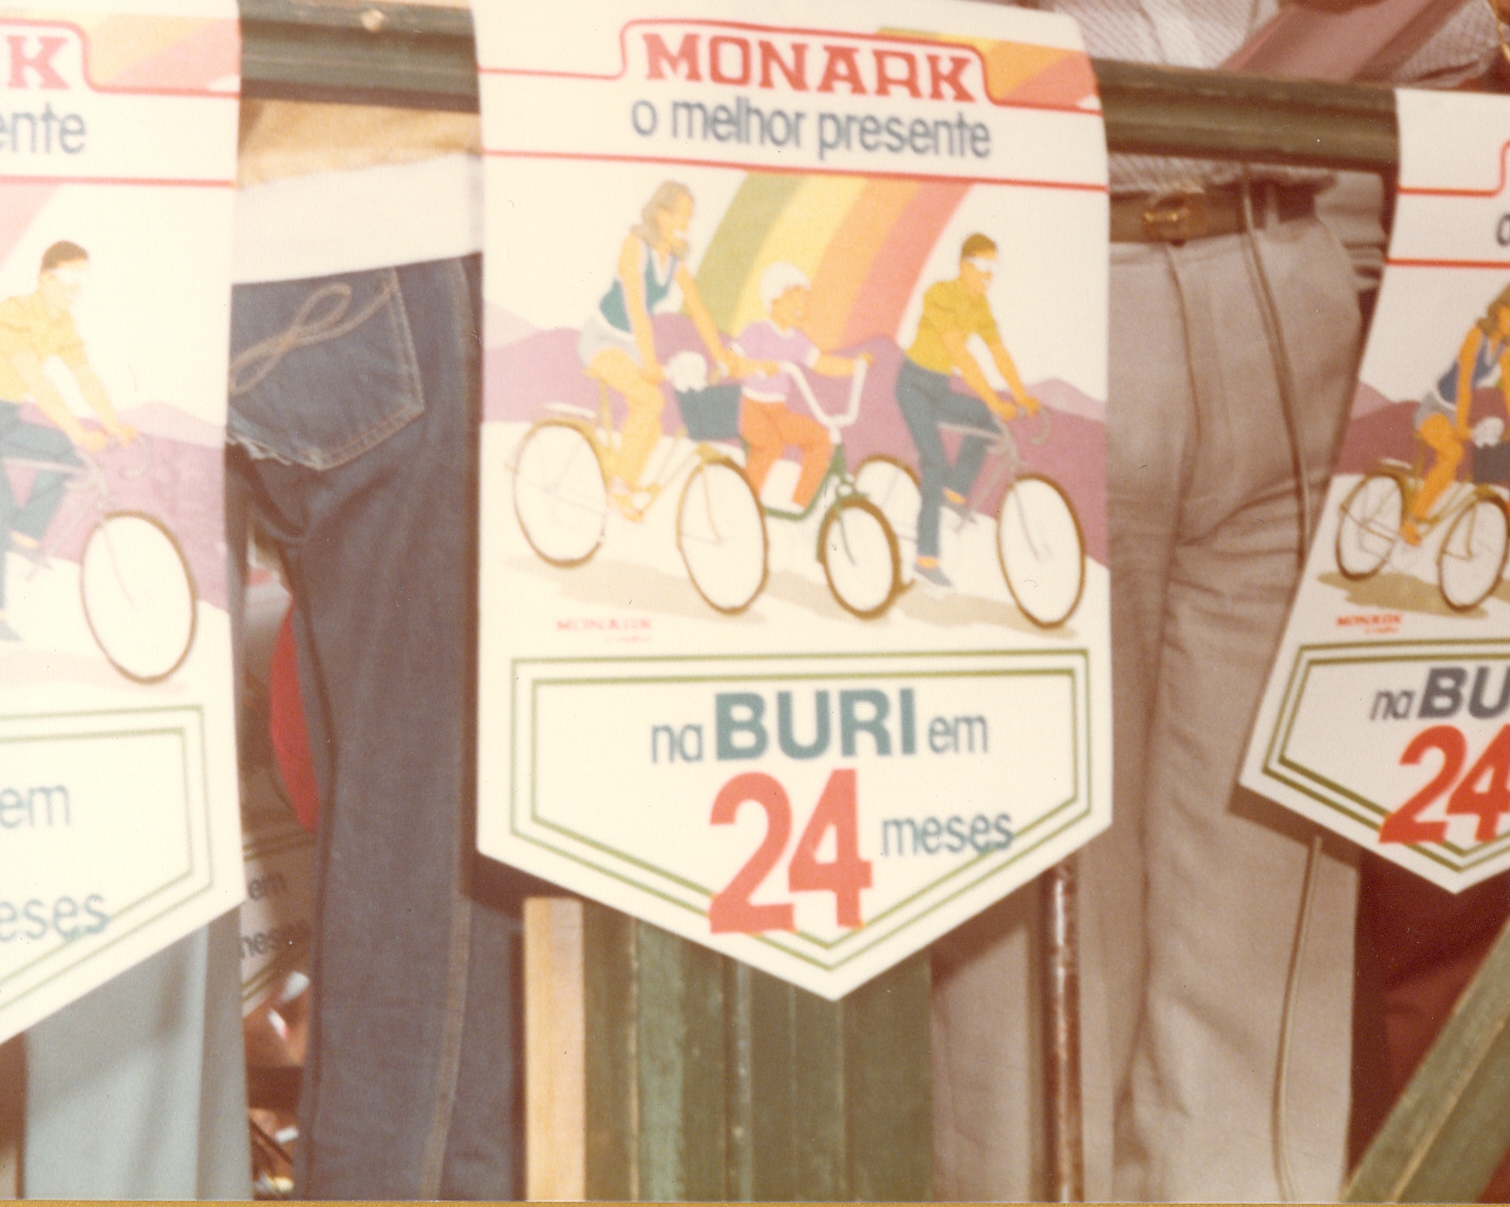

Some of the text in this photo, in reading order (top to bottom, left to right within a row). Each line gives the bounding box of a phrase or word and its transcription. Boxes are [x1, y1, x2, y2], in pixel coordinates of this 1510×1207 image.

[641, 32, 978, 104] MONARK
[631, 95, 992, 161] o melhor presente
[651, 687, 990, 765] na BURI em
[1371, 689, 1411, 721] na
[0, 784, 71, 829] em
[708, 768, 1016, 935] 24 meses
